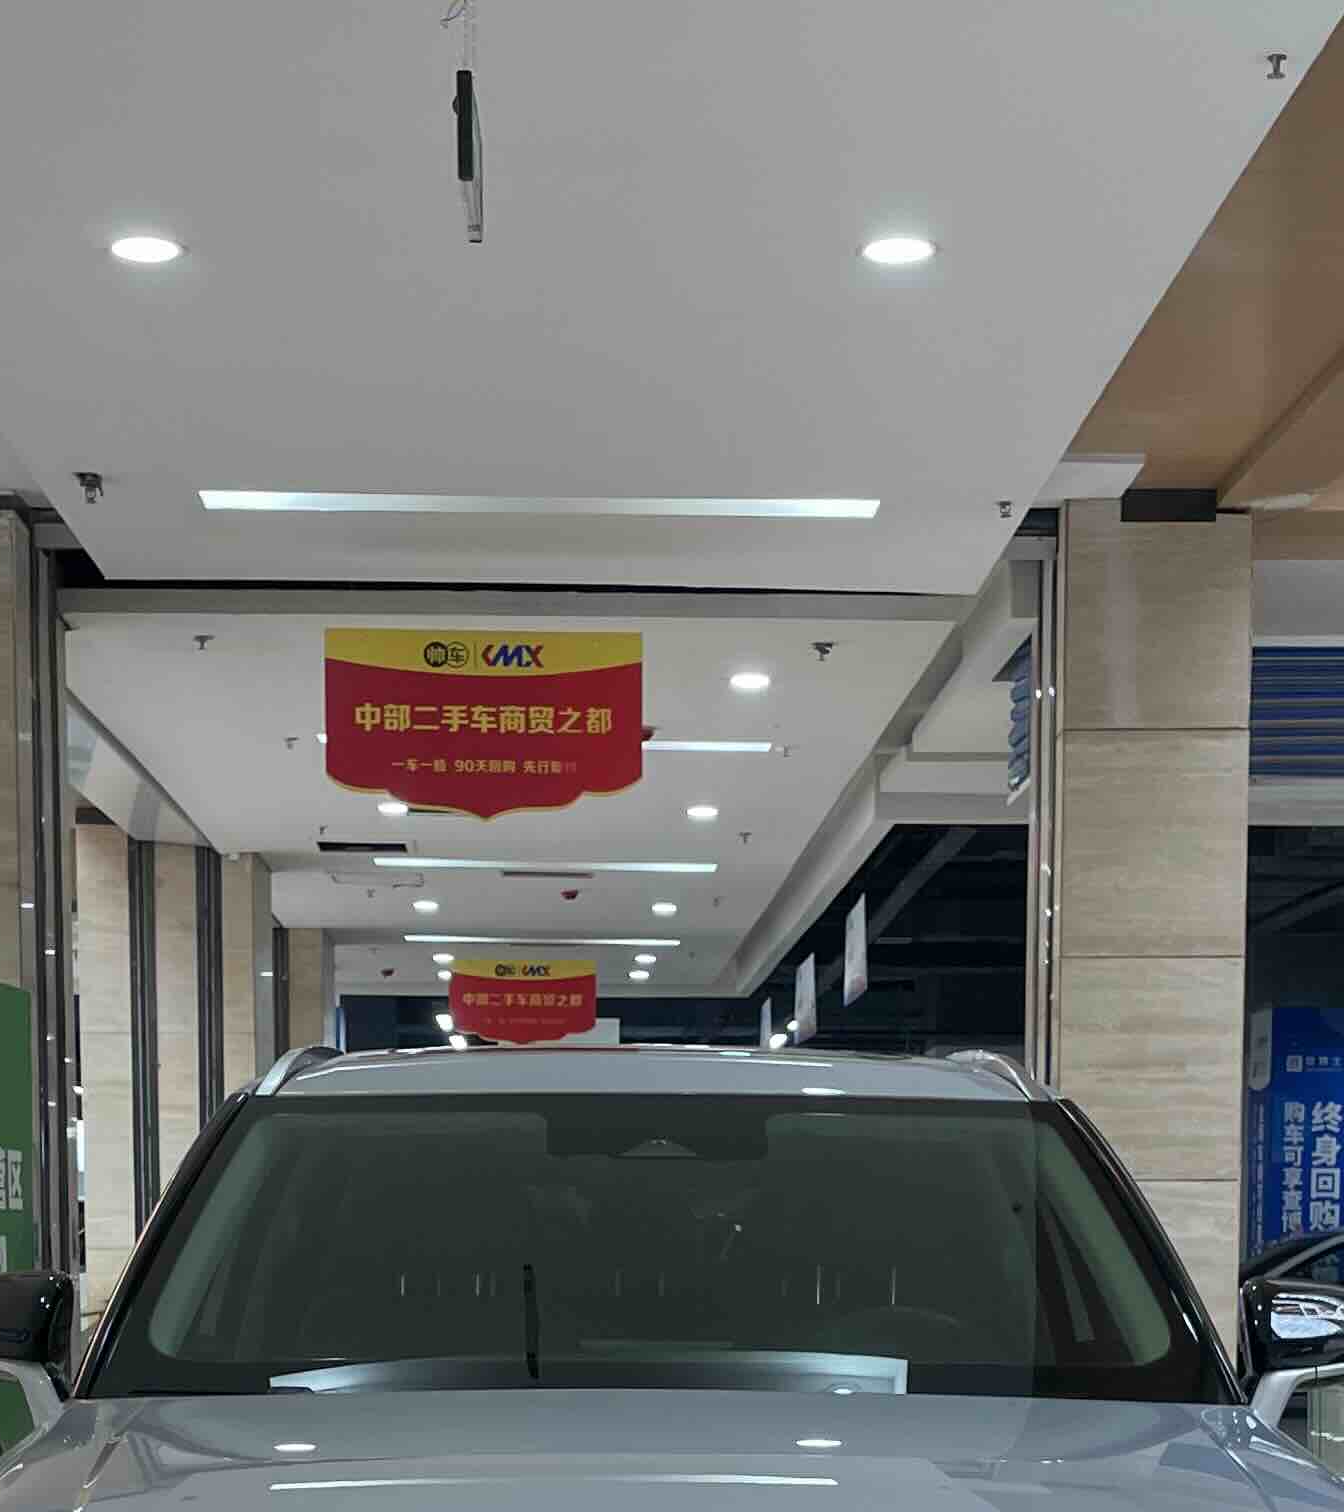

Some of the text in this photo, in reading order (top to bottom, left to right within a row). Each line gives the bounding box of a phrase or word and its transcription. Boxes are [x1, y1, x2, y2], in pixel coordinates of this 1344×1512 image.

[355, 703, 612, 735] 中部二手车商贸之都
